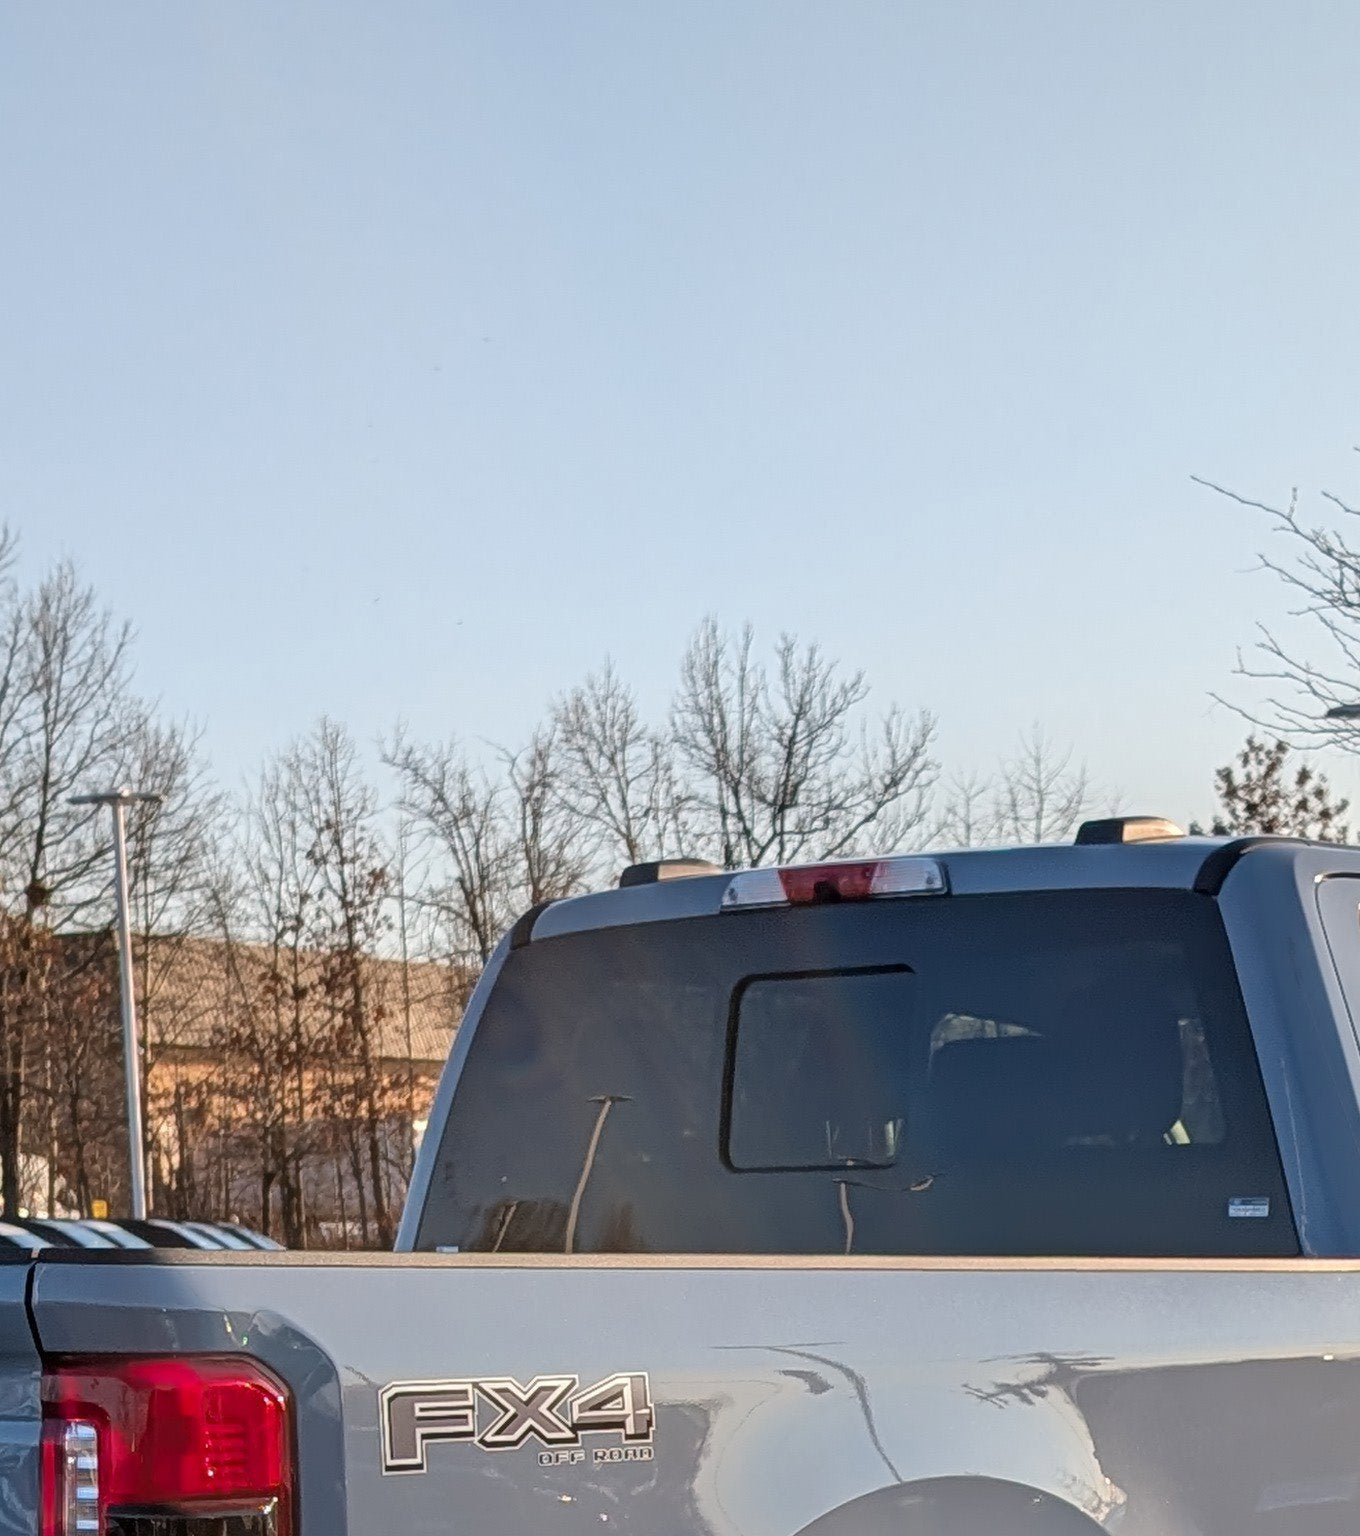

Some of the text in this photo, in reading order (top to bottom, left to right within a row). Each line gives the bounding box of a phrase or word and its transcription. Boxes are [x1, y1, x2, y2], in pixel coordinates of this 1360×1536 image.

[378, 1372, 656, 1475] FX4
[538, 1446, 654, 1466] OFF ROAD
